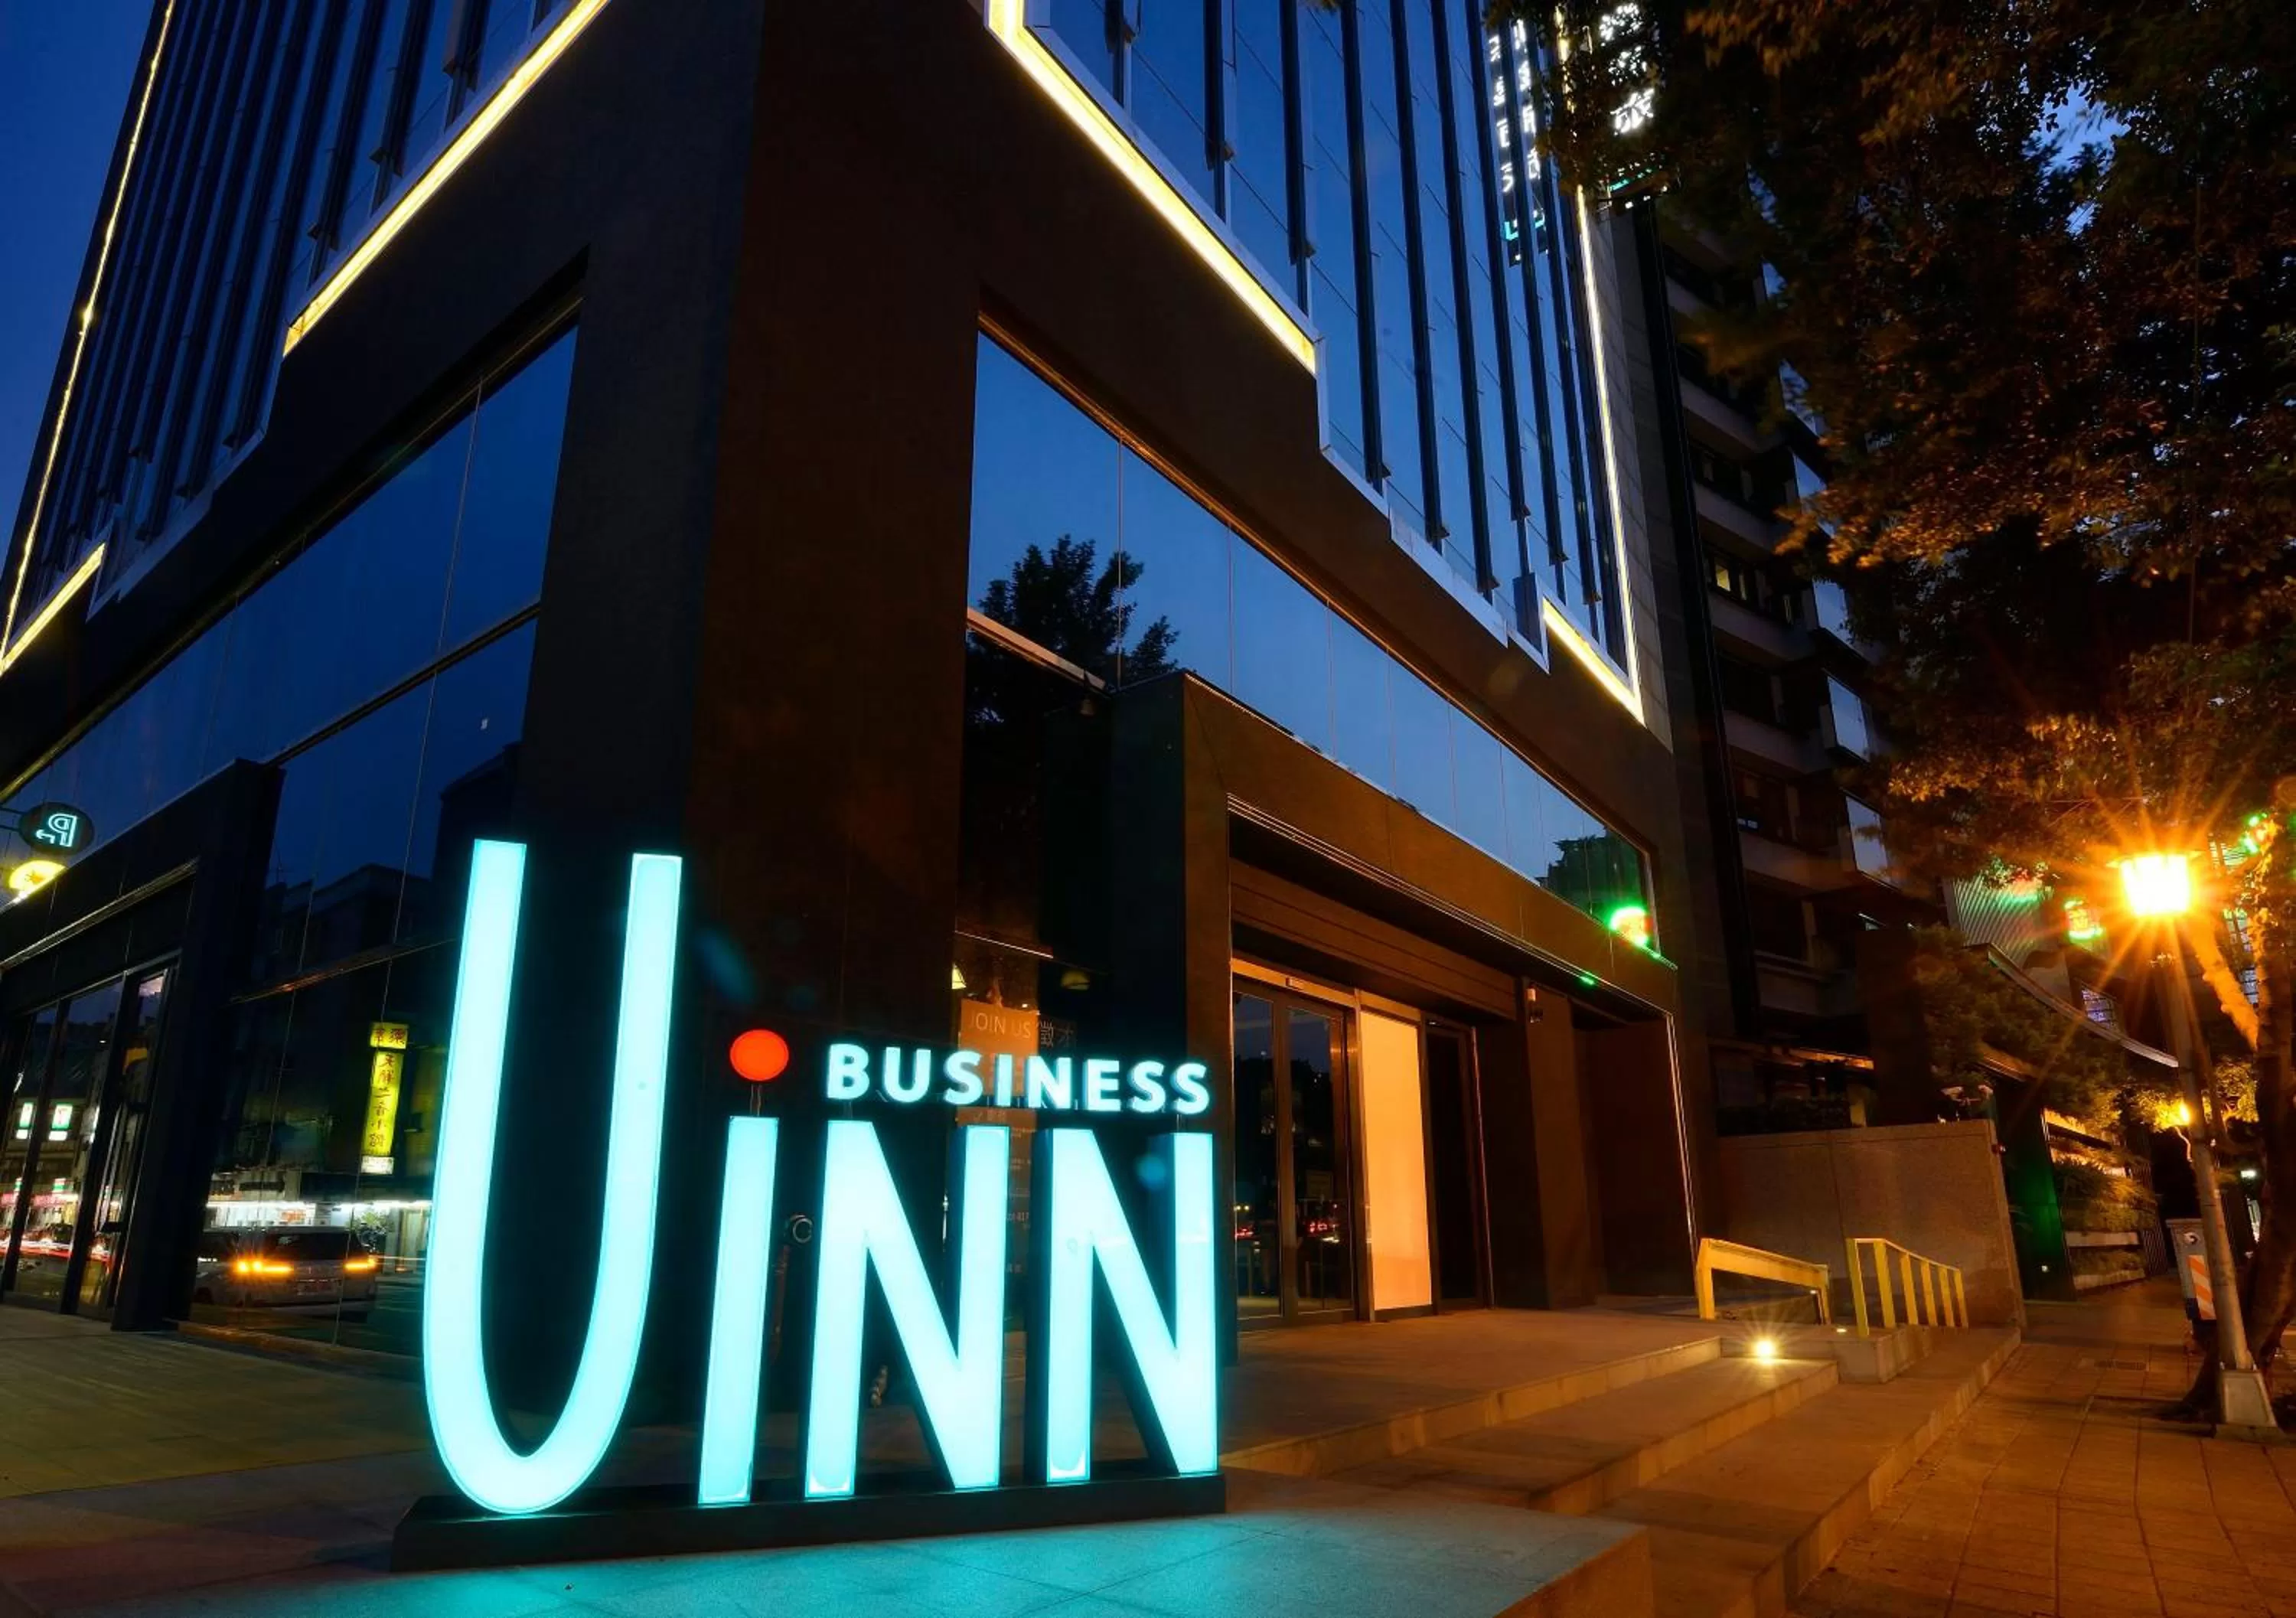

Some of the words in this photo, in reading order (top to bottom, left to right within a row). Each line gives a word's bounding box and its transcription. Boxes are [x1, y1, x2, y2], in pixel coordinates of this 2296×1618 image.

[970, 1012, 1006, 1035] JOIN
[1011, 1019, 1032, 1039] US
[826, 1042, 1210, 1116] BUSINESS
